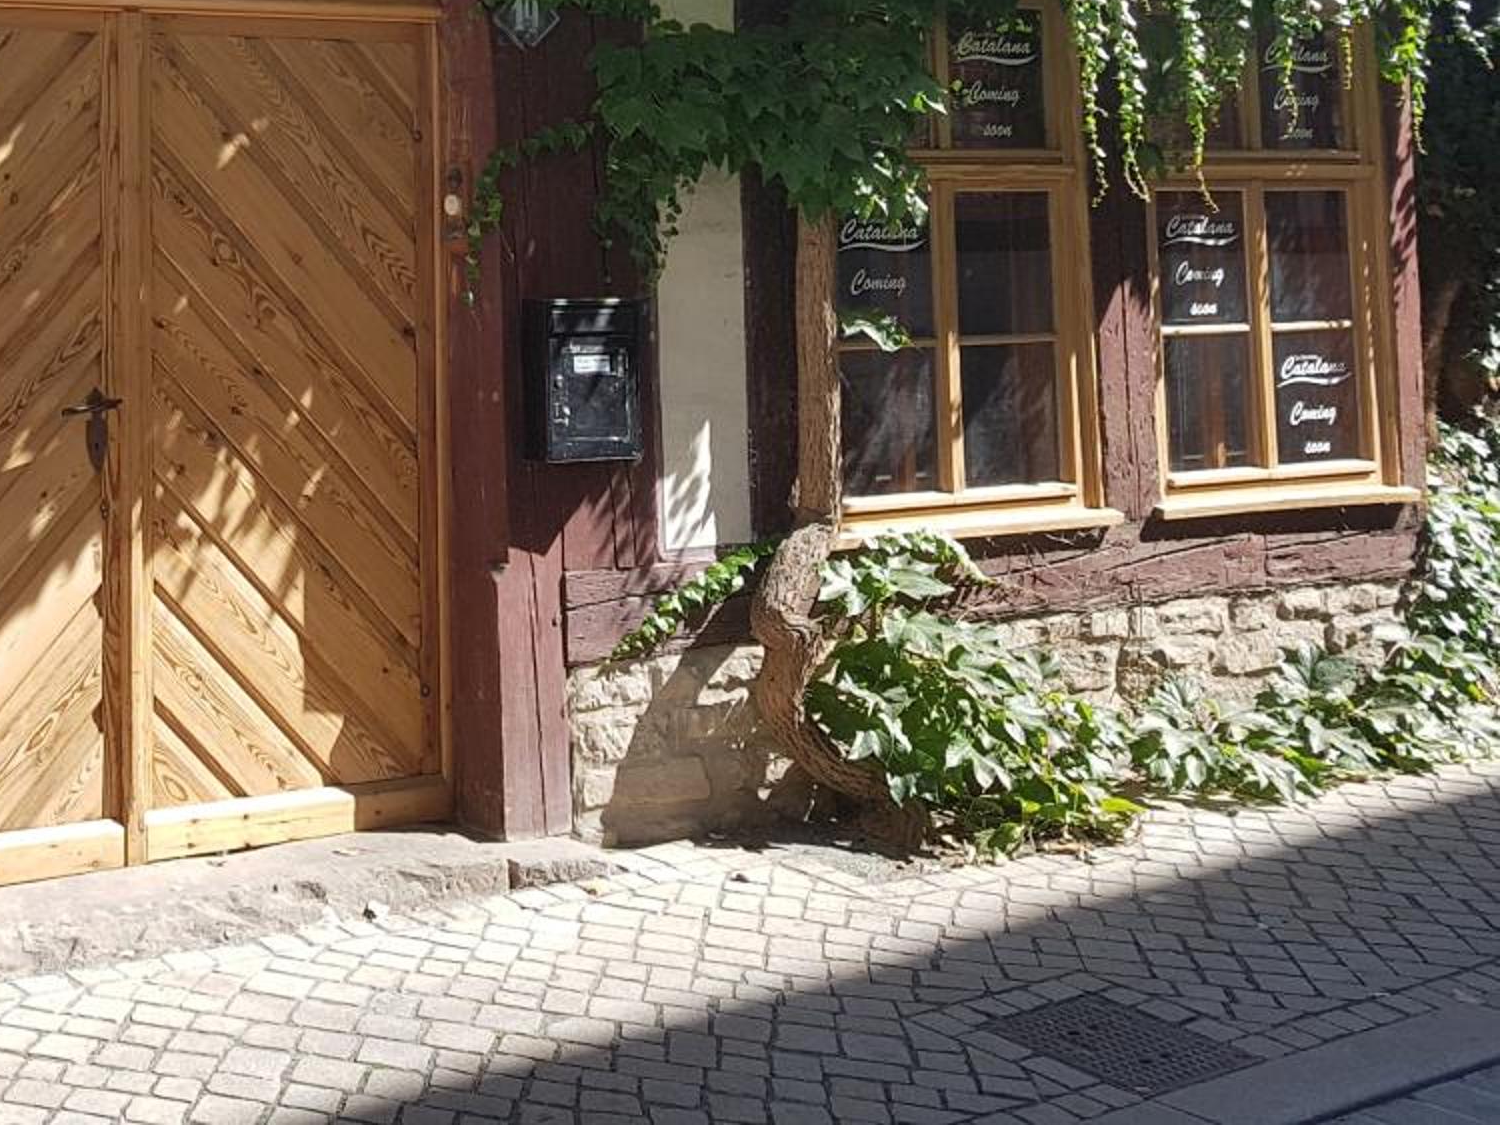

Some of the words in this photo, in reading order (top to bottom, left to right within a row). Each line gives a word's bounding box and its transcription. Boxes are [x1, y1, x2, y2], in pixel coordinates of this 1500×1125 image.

[957, 31, 1031, 56] Catalana
[1165, 215, 1235, 238] Catalana
[850, 269, 907, 296] Coming
[1176, 261, 1224, 286] Coming
[1189, 301, 1218, 316] soon
[1281, 355, 1347, 379] Catalana
[1289, 401, 1337, 426] Coming
[1304, 442, 1331, 454] soon
